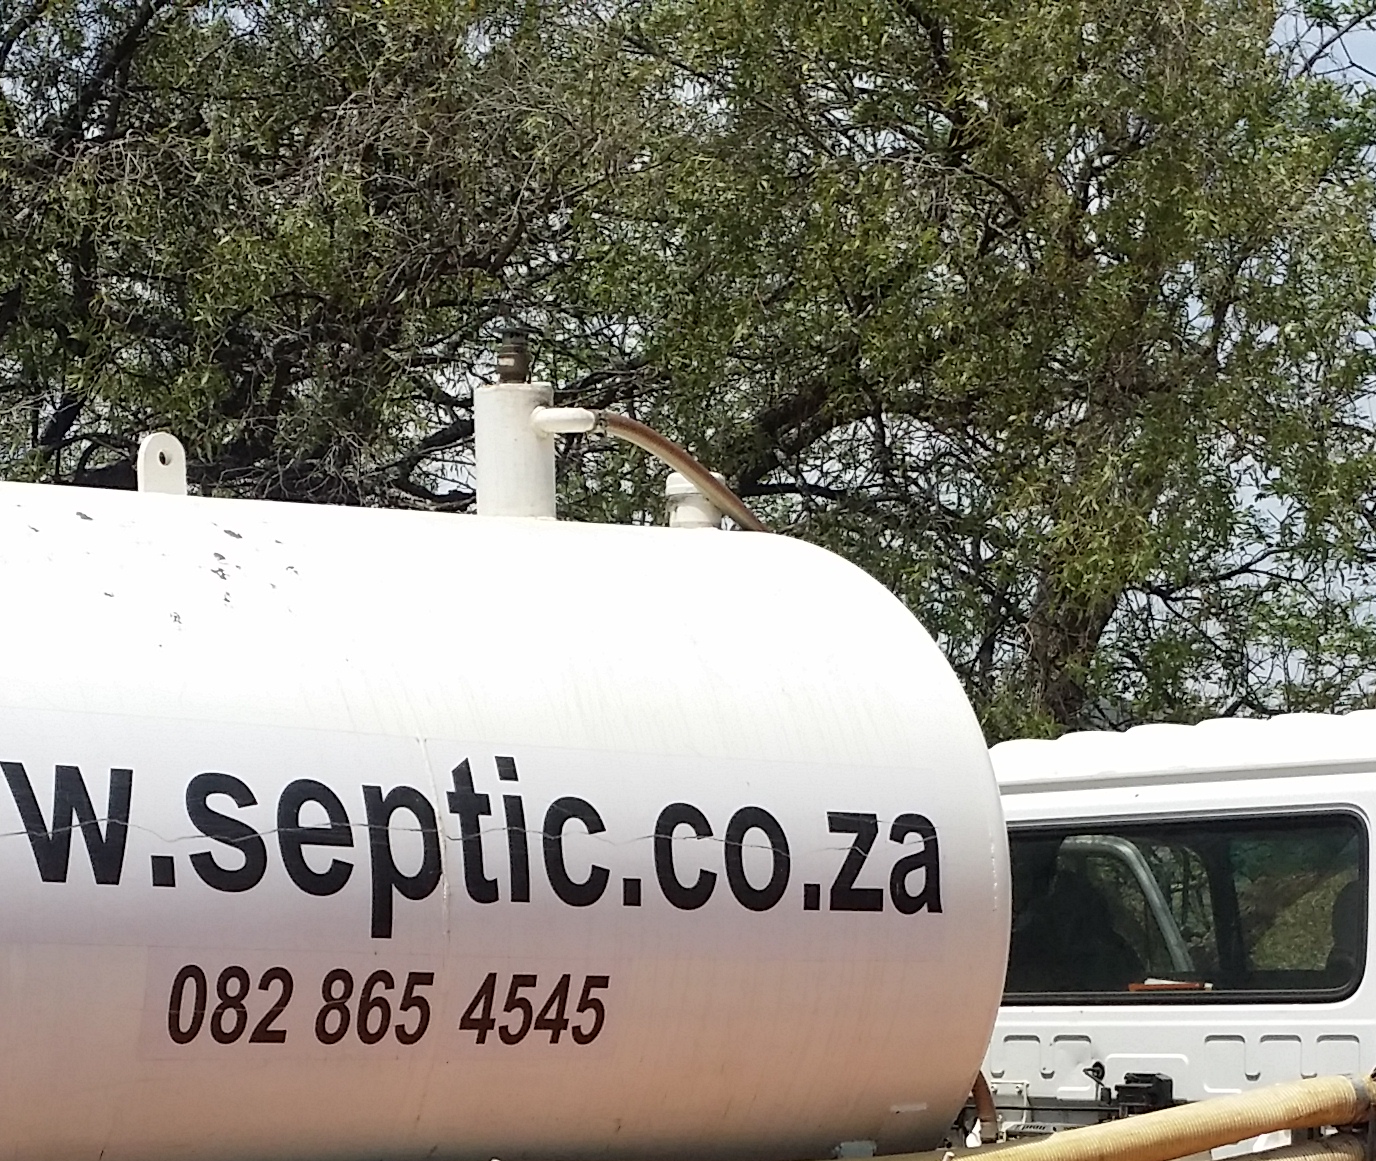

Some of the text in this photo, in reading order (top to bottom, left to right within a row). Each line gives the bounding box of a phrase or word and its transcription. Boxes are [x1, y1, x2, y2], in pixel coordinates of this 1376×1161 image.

[166, 964, 611, 1047] 082 865 4545
